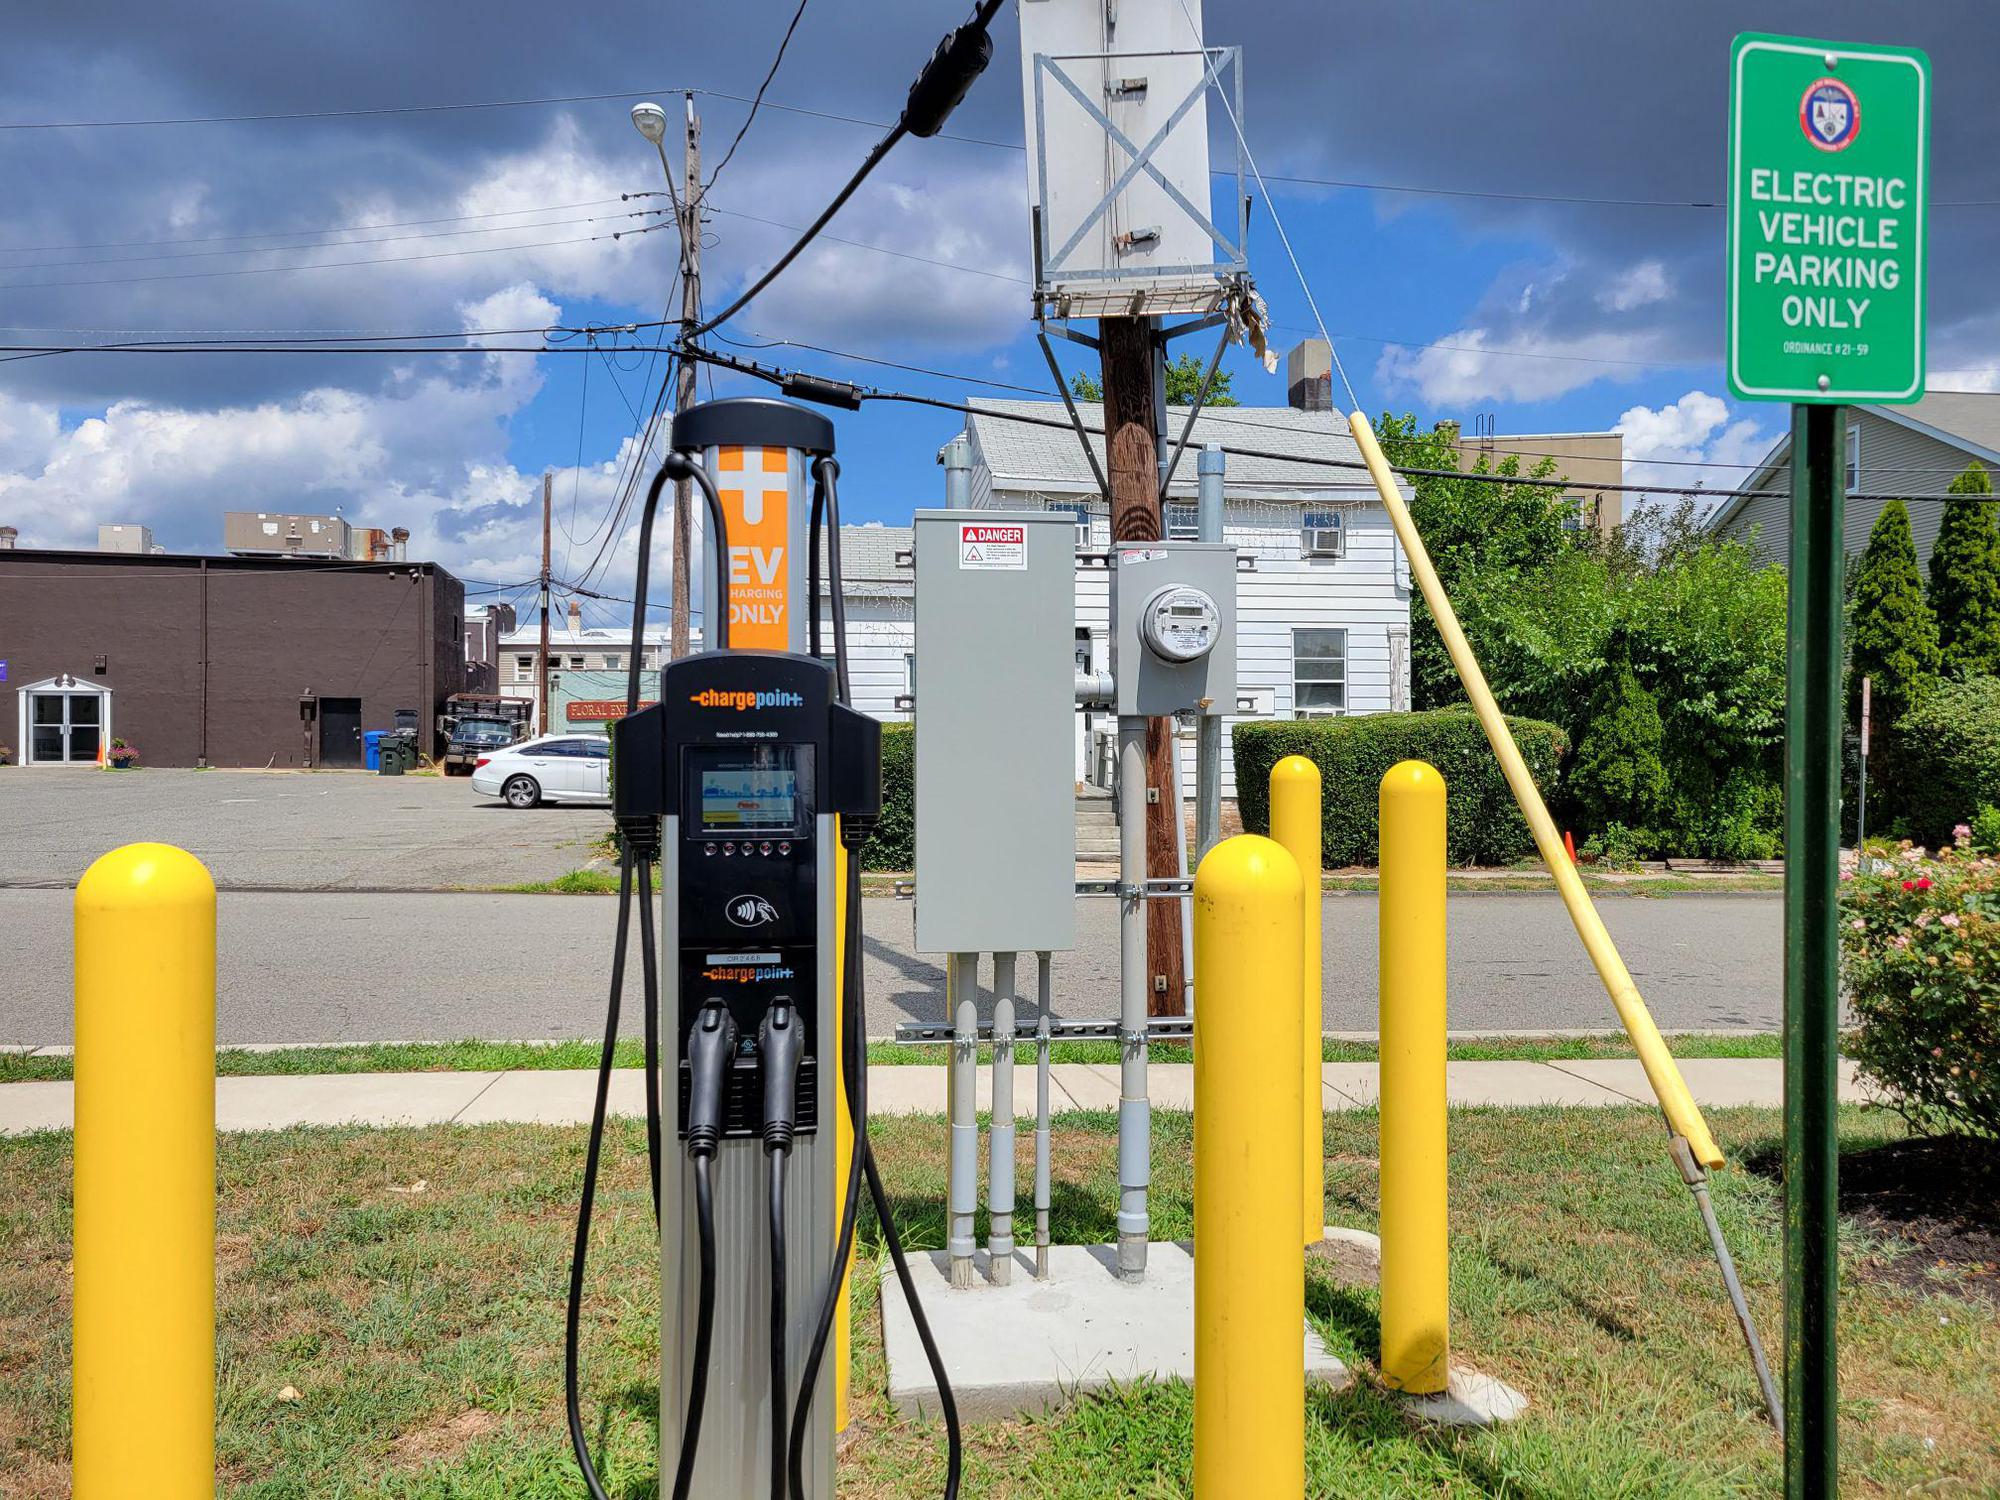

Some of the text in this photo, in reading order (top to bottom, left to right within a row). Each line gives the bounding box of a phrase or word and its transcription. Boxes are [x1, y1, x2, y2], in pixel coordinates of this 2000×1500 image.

[1751, 168, 1905, 209] ELECTRIC
[1759, 211, 1899, 250] VEHICLE
[1755, 252, 1900, 291] PARKING
[1782, 296, 1871, 329] ONLY
[1783, 341, 1833, 355] ORDINANCE
[978, 528, 1022, 542] DANGER
[730, 546, 784, 585] EV
[730, 588, 784, 600] HARGING
[729, 603, 784, 625] ONLY
[571, 704, 607, 716] FLORAL
